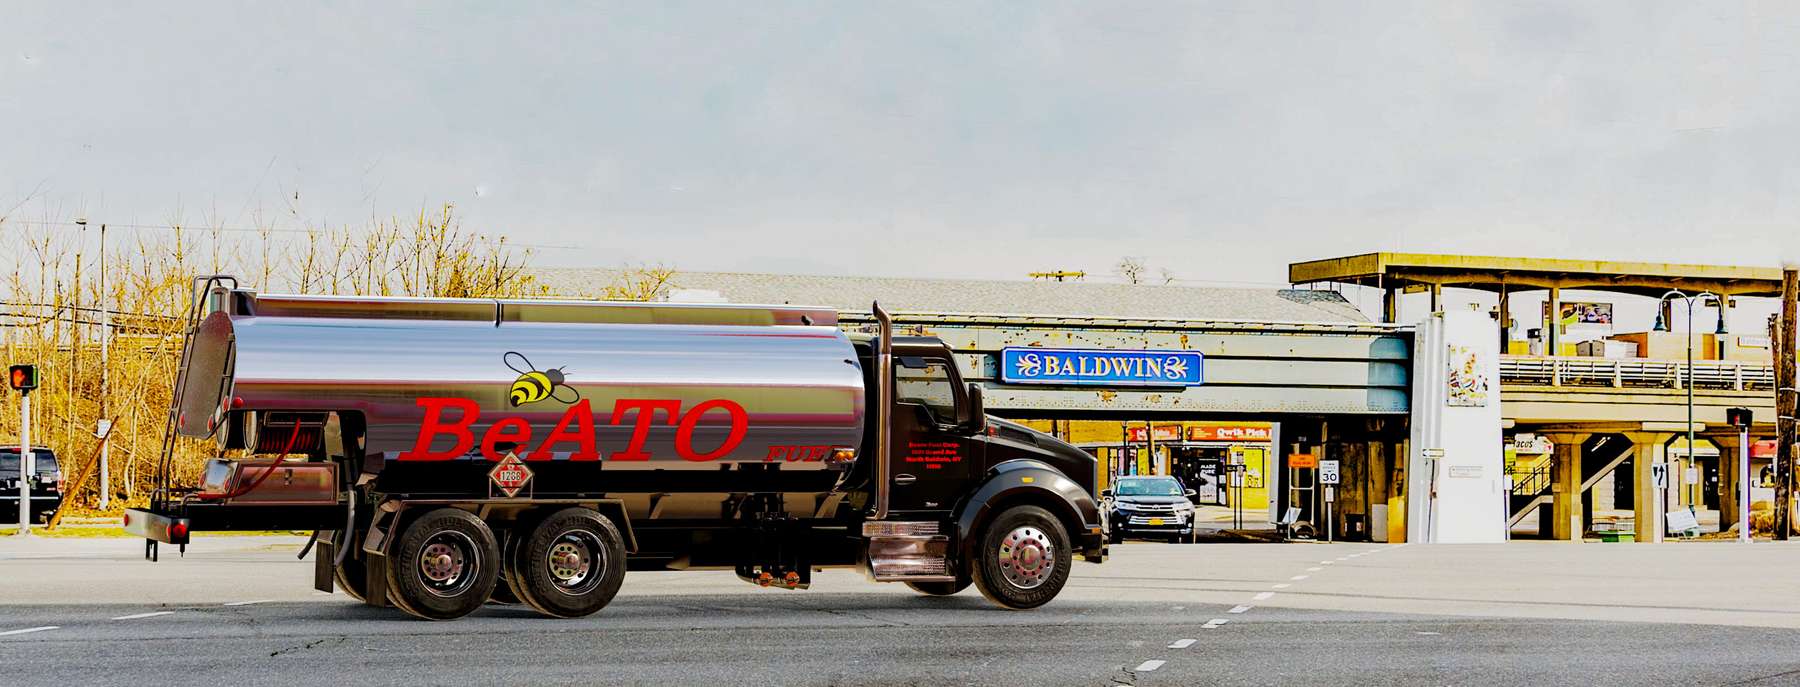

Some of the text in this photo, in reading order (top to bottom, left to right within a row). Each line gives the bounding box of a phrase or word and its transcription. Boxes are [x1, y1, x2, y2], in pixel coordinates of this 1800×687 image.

[1044, 355, 1163, 377] BALDWIN
[398, 397, 749, 462] BeATO
[1216, 428, 1243, 438] Qwik
[1245, 428, 1264, 438] Pick
[763, 445, 838, 462] FUE
[1323, 473, 1337, 481] 30
